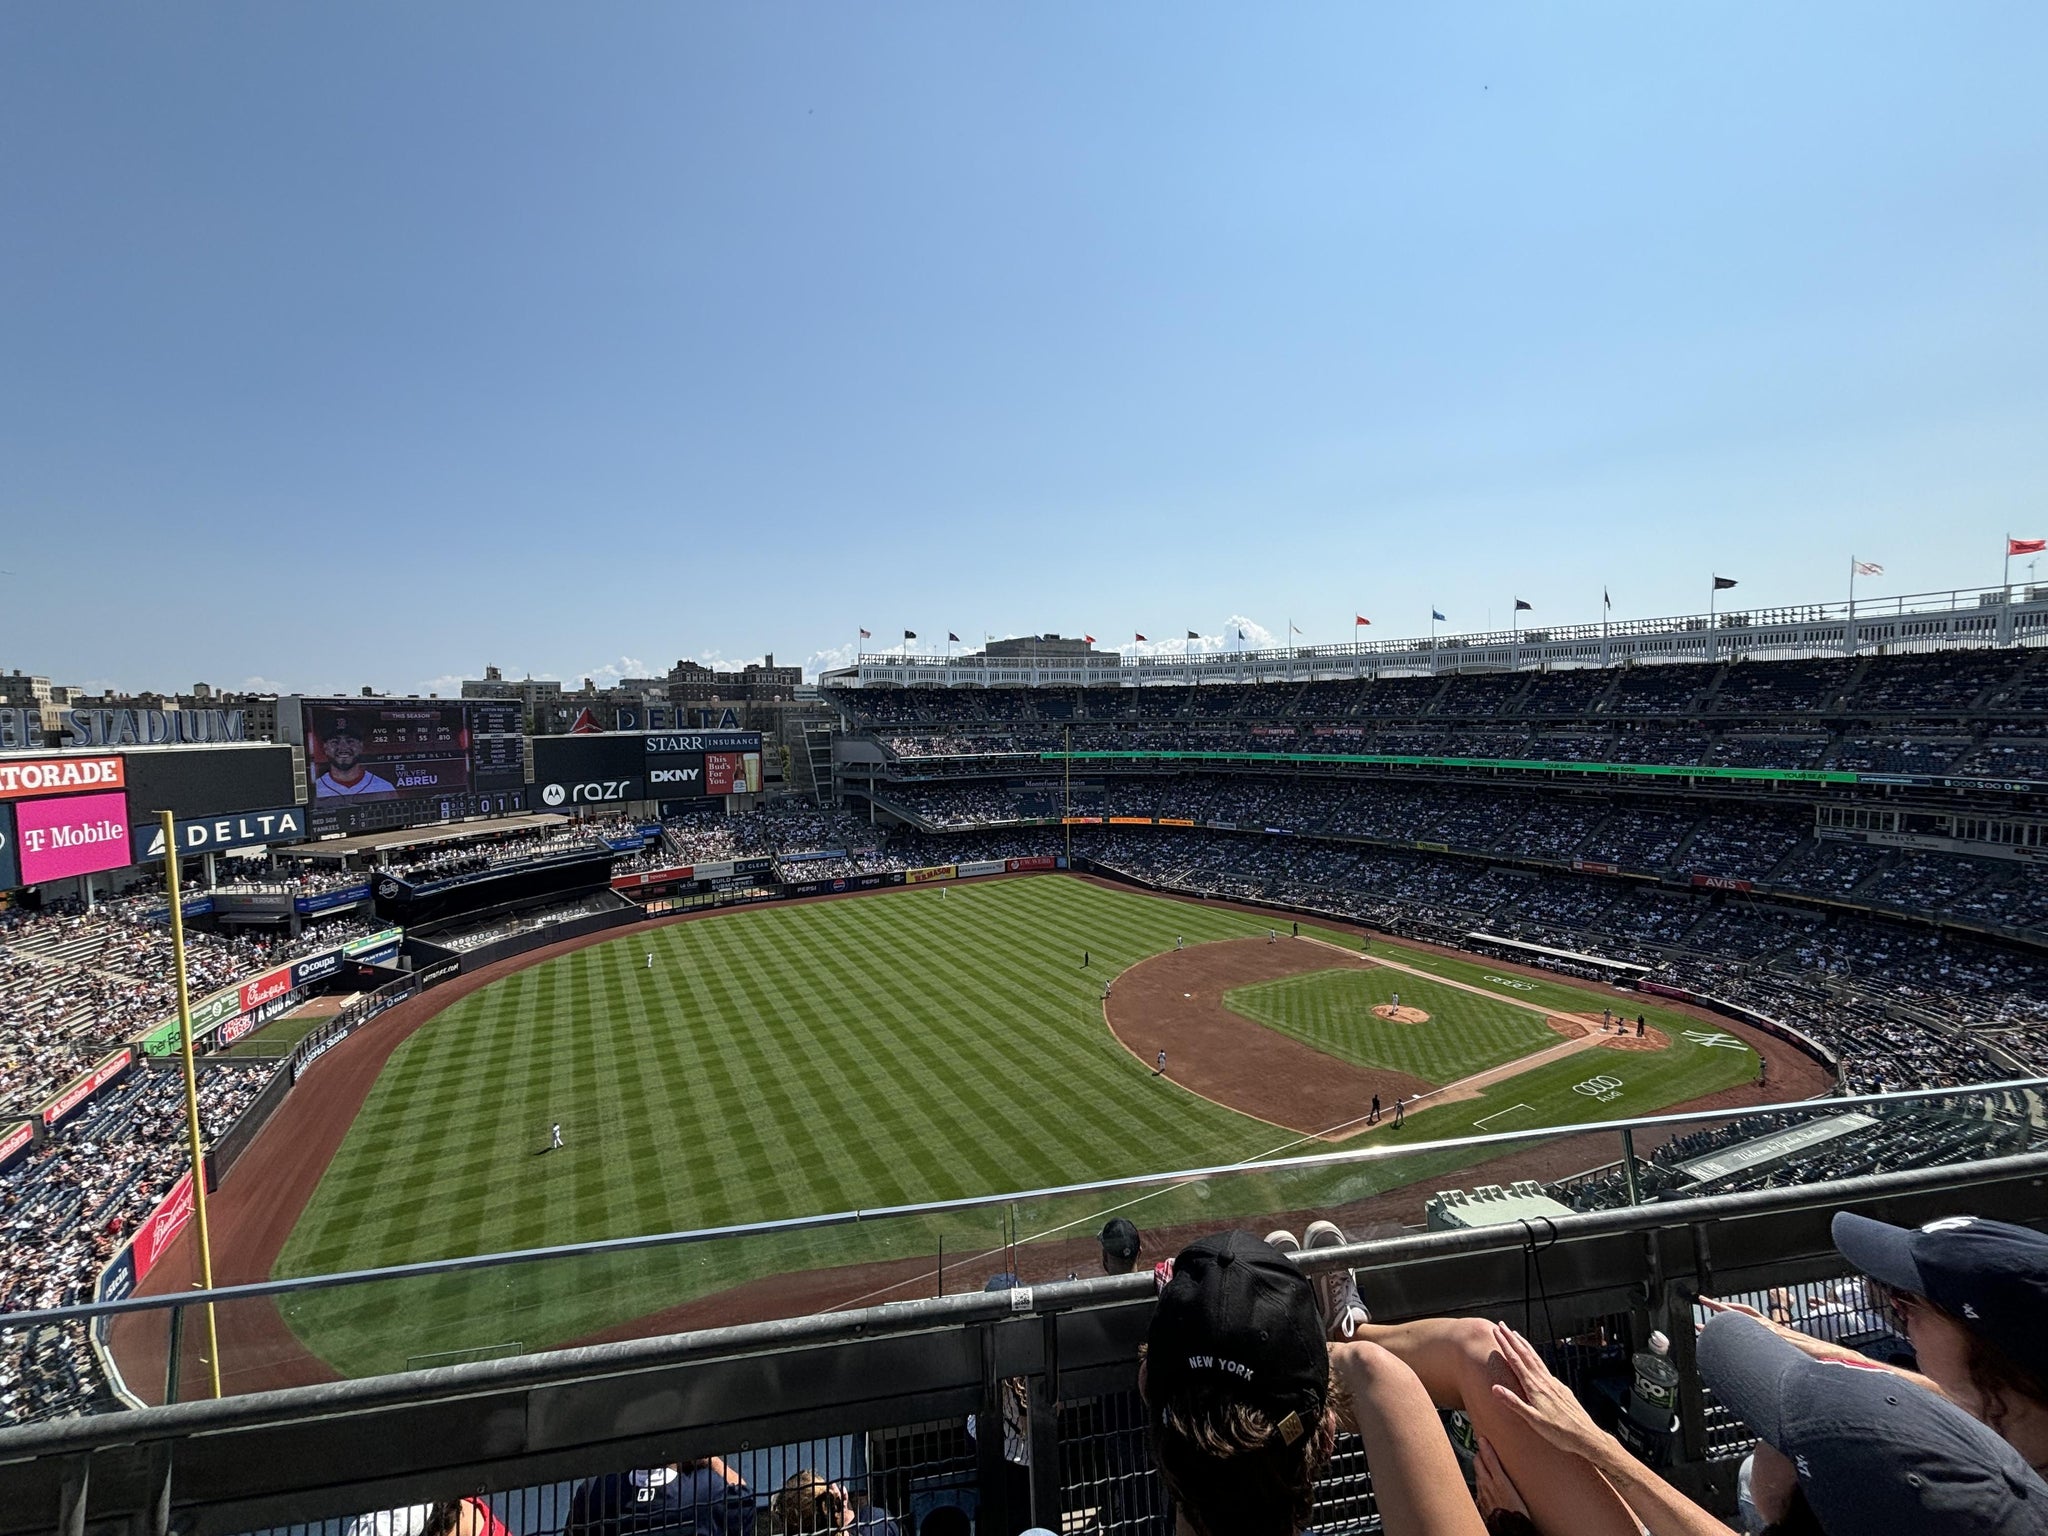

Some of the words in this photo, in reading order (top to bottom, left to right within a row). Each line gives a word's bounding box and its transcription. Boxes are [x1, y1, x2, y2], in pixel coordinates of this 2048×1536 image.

[616, 706, 740, 731] DELTA
[67, 708, 246, 747] STADIUM
[646, 736, 705, 751] STARR
[708, 737, 759, 746] INSURANCE
[708, 755, 727, 763] This
[708, 762, 731, 771] Bud's
[0, 761, 118, 791] TORADE
[396, 775, 438, 787] ABREU
[650, 768, 699, 783] DKNY
[573, 781, 630, 802] razr
[481, 800, 490, 812] 0
[498, 798, 504, 810] 1
[514, 797, 519, 808] 1
[187, 813, 298, 847] DELTA
[313, 824, 340, 833] YANKEES
[712, 880, 754, 890] SUBMARINES
[1706, 878, 1736, 889] AVIS
[309, 956, 335, 971] coupa
[326, 1030, 348, 1048] StubHub
[1188, 1356, 1214, 1369] NEW
[1218, 1358, 1254, 1382] YORK
